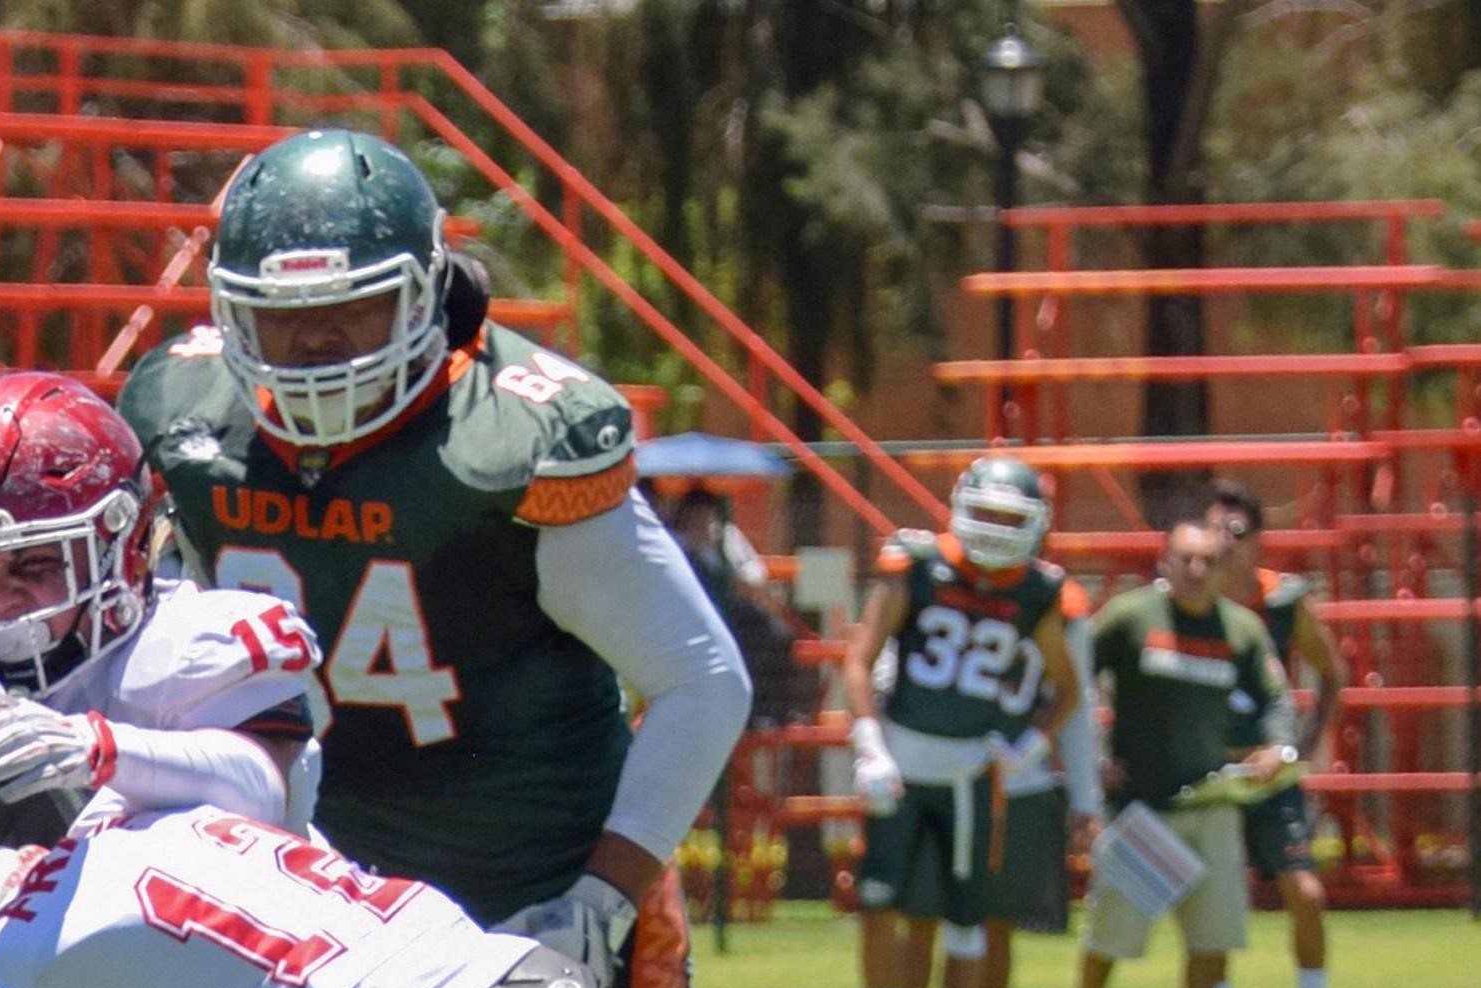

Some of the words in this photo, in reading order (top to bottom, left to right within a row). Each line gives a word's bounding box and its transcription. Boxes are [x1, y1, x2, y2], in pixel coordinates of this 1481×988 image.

[492, 352, 590, 403] 64
[230, 603, 312, 672] 15
[906, 605, 1019, 700] 32
